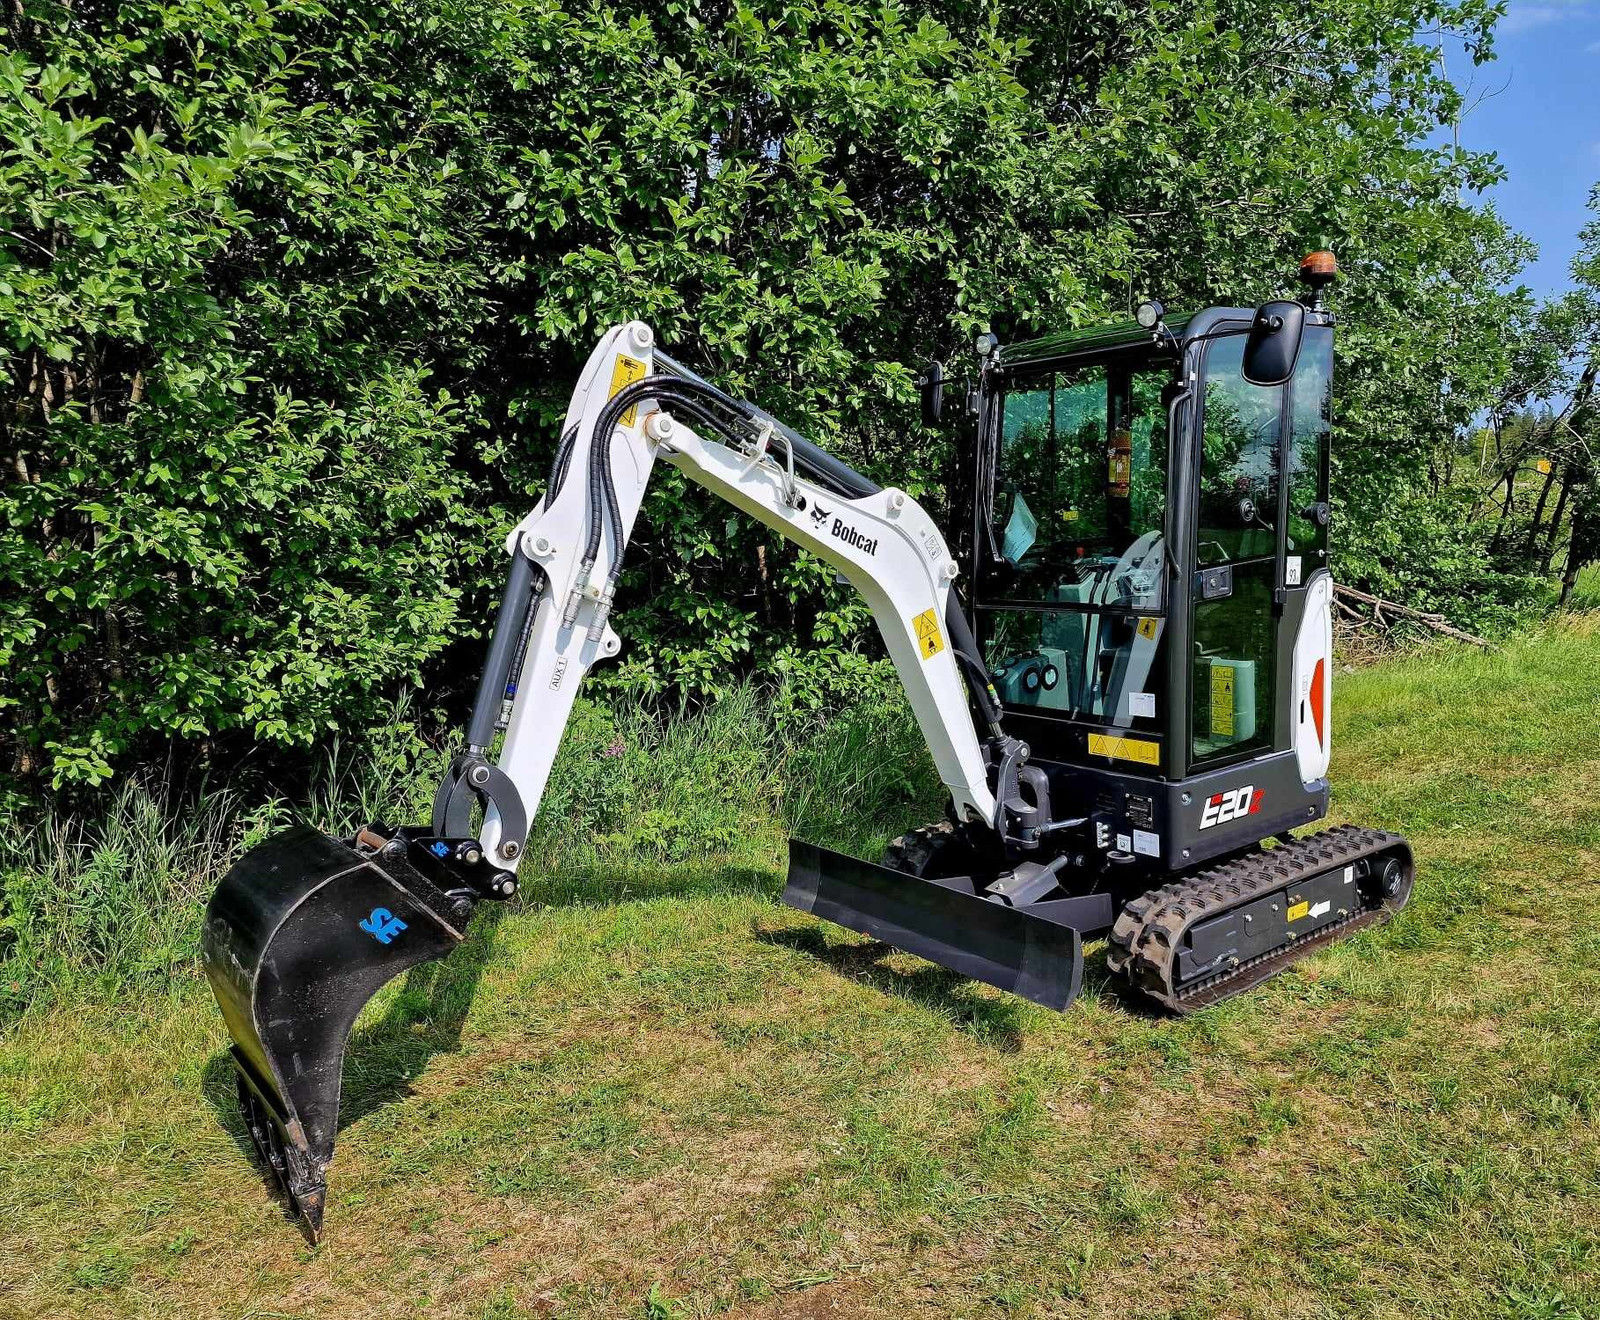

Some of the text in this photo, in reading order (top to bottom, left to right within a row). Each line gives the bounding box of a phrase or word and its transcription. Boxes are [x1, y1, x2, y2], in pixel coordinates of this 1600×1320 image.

[831, 518, 879, 557] Bobcat
[552, 667, 563, 688] AUX
[430, 841, 450, 857] SE
[359, 907, 408, 944] SE
